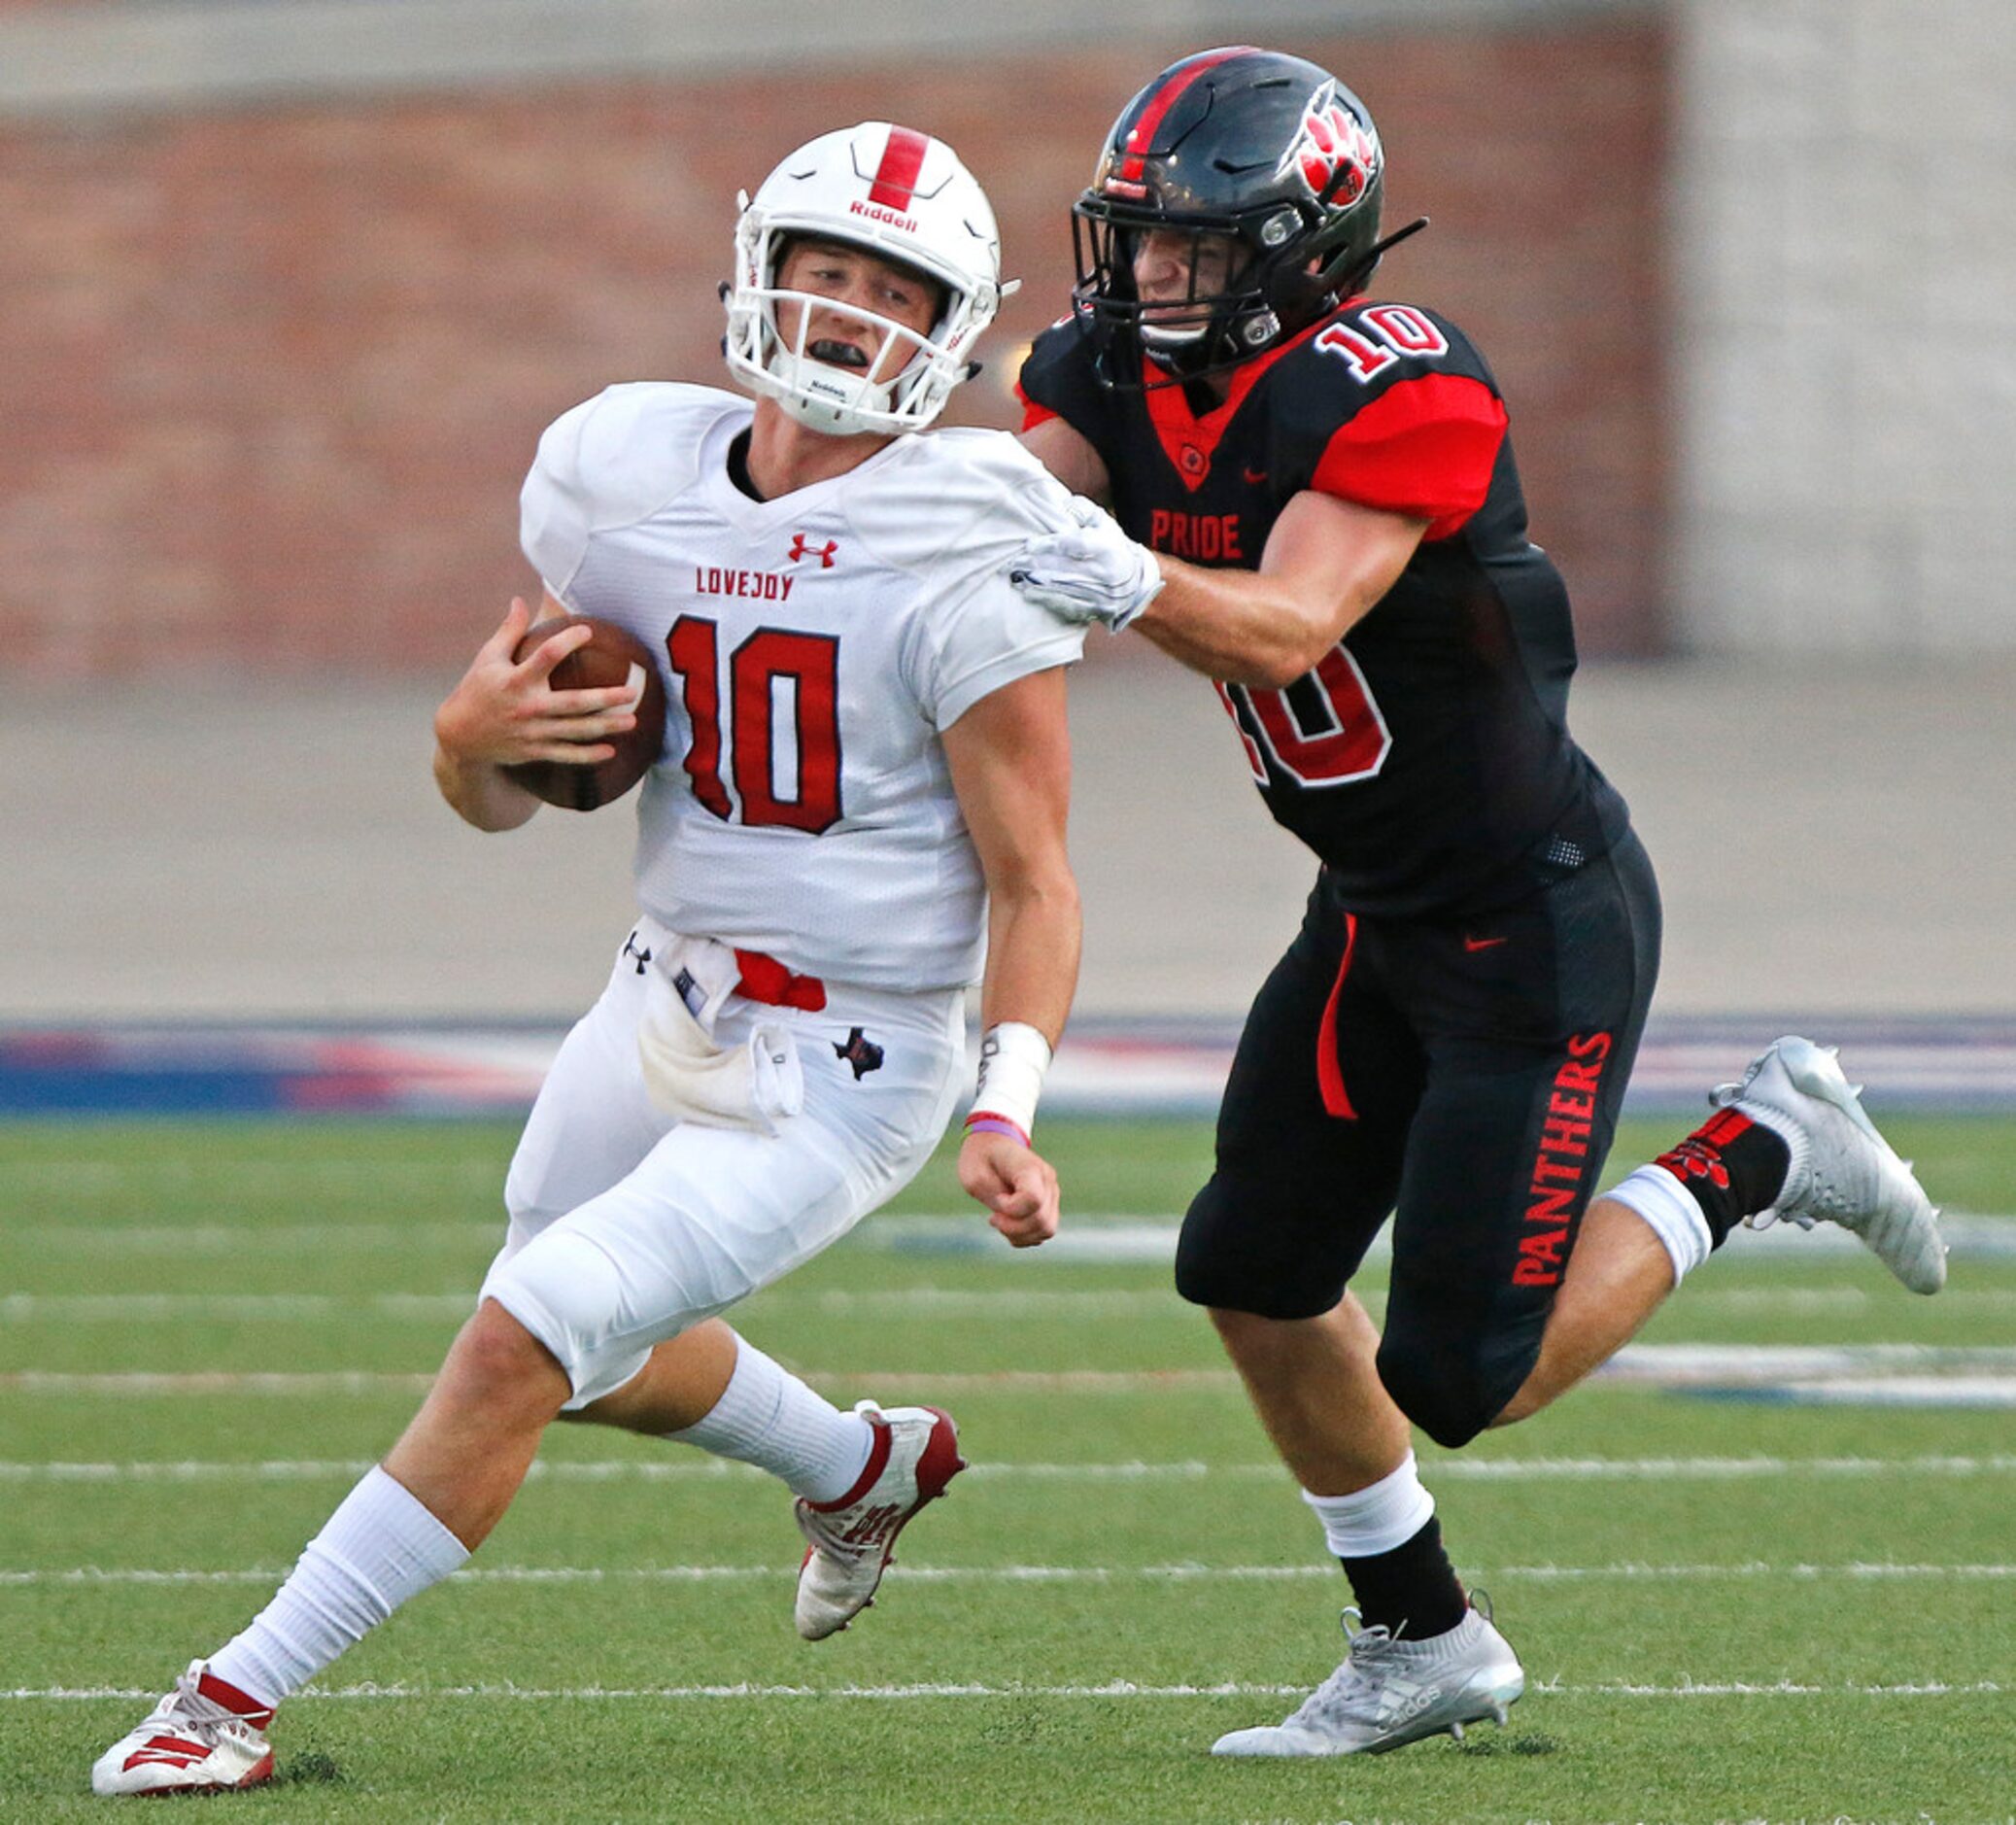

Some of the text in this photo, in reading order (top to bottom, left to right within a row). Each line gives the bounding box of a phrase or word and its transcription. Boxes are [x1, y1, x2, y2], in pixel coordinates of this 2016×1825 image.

[849, 200, 918, 233] Riddell
[1314, 304, 1449, 385] 10
[1151, 508, 1243, 560] PRIDE
[697, 567, 794, 602] LOVEJOY
[666, 613, 844, 836] 10
[1512, 1031, 1613, 1286] PANTHERS
